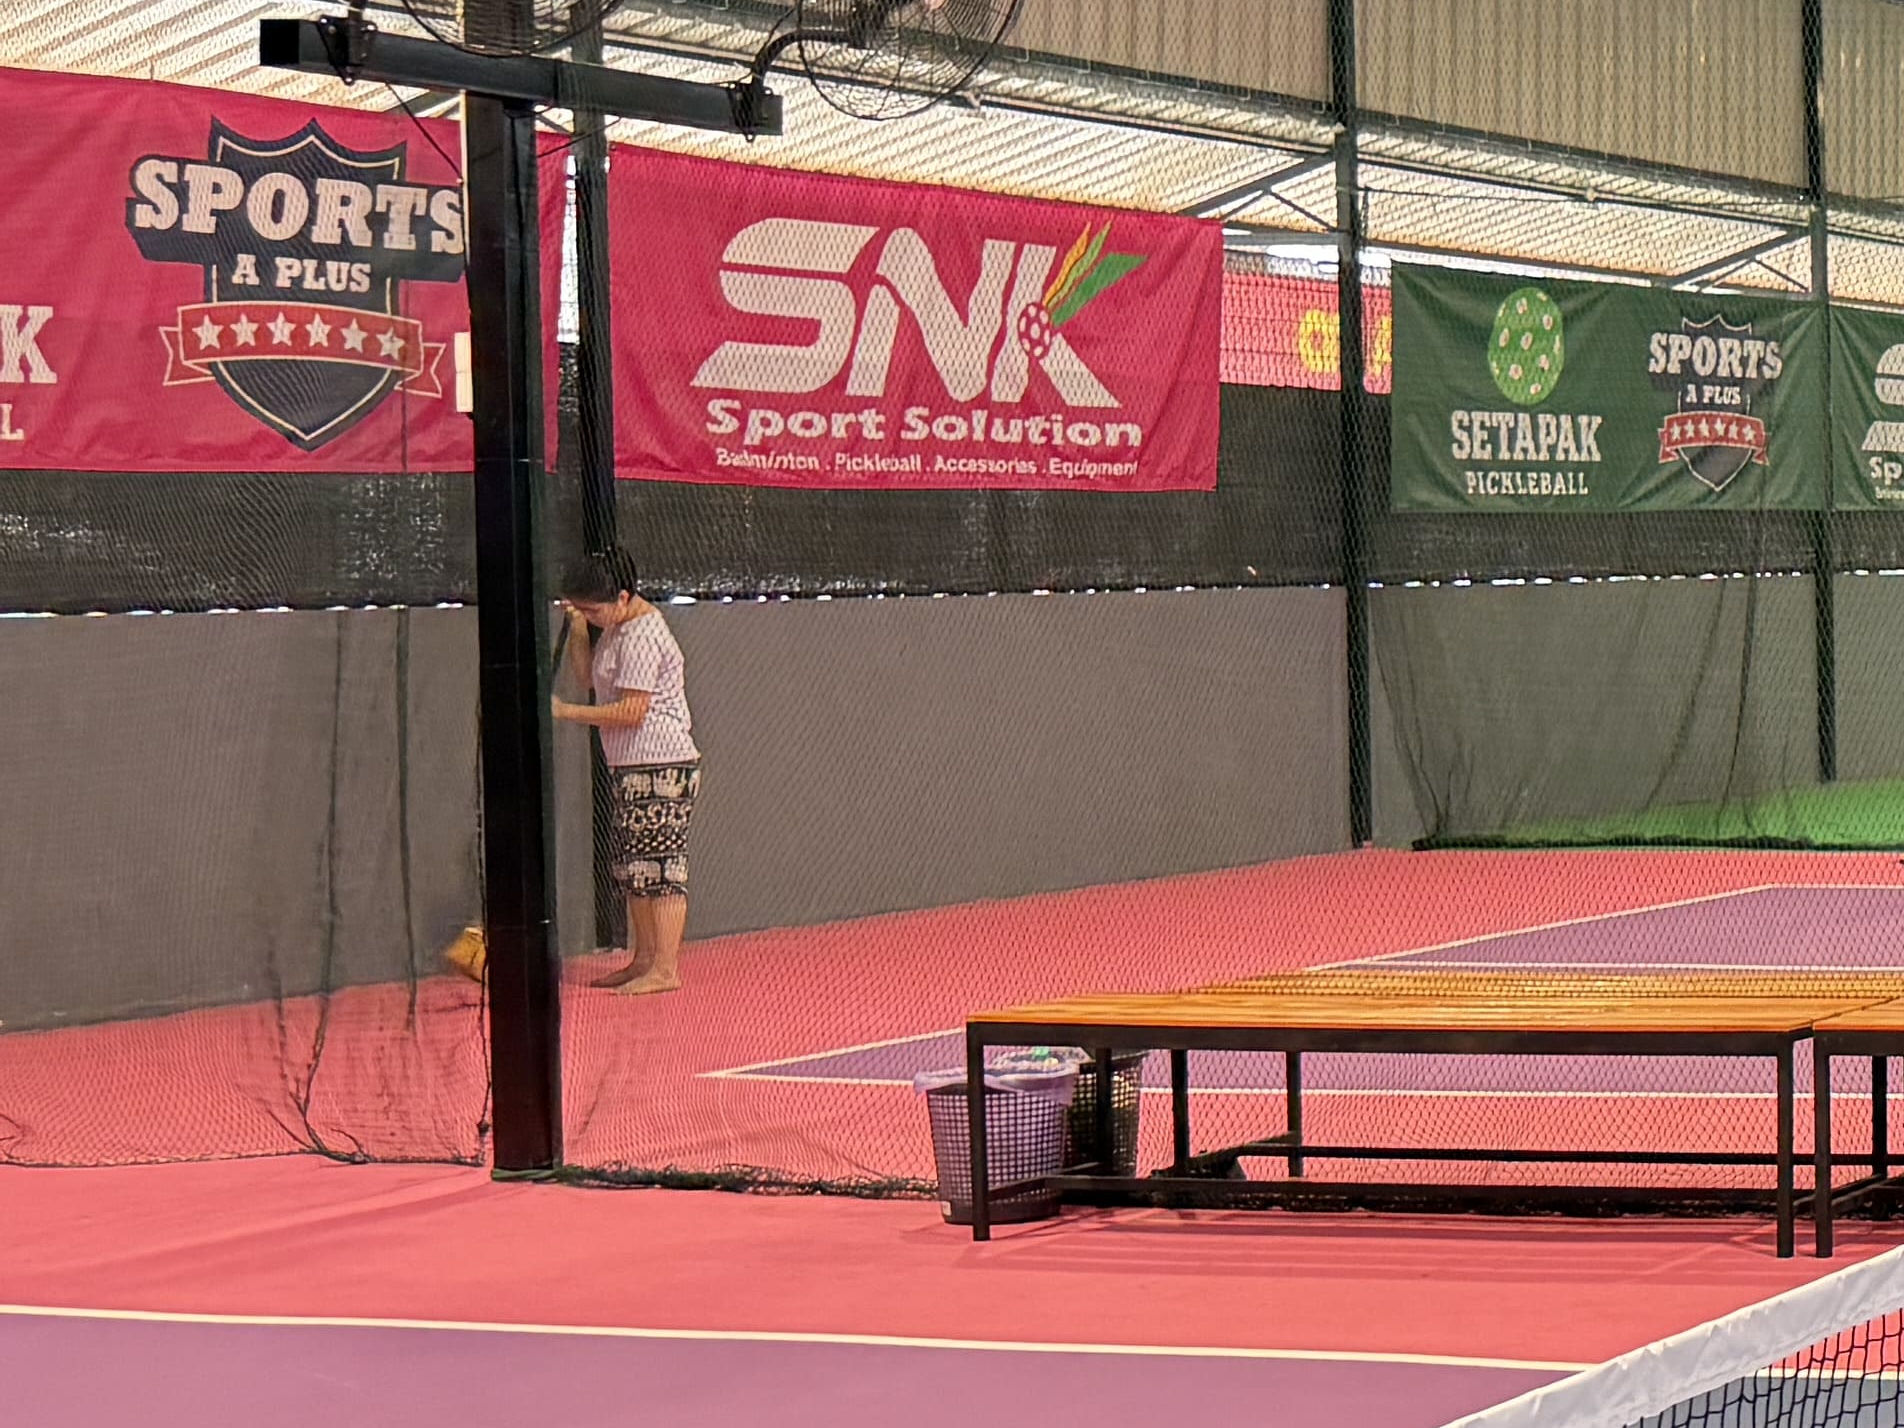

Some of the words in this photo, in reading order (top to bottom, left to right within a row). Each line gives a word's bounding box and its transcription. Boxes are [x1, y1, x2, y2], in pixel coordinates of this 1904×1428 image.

[134, 159, 464, 254] SPORTS
[232, 253, 259, 286] A
[275, 256, 372, 293] PLUS
[690, 217, 1146, 408] SNK
[1649, 332, 1784, 380] SPORTS
[1686, 384, 1698, 402] A
[1703, 384, 1742, 405] PLUS
[706, 398, 886, 445] Sport
[900, 406, 1143, 447] Solution
[1451, 410, 1603, 462] SETAPAK
[835, 454, 921, 473] Pickleball
[935, 456, 1036, 474] Accessories
[1049, 459, 1138, 479] Equipment
[1466, 471, 1589, 496] PICKLEBALL
